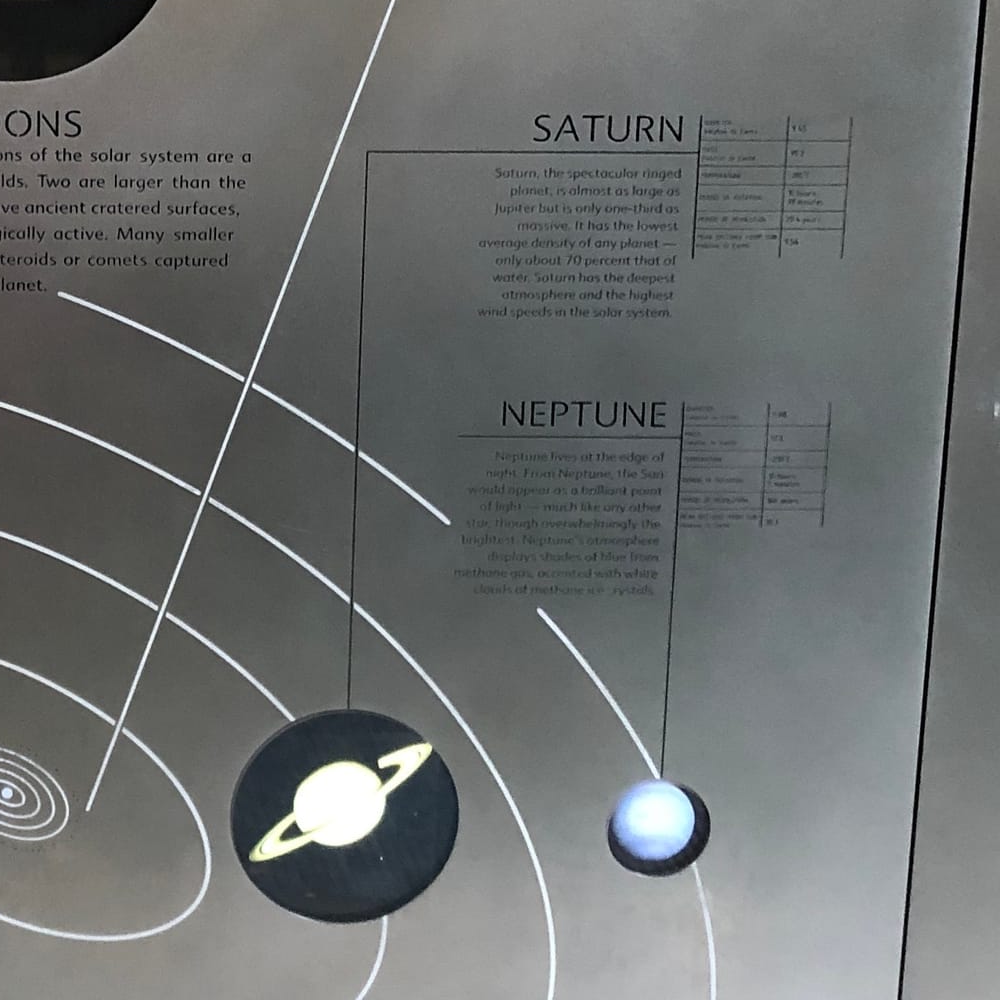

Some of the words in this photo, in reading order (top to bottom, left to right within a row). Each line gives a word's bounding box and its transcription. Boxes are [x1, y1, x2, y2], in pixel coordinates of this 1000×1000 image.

[532, 114, 685, 143] SATURN
[30, 147, 46, 162] of
[55, 147, 81, 162] the
[90, 147, 130, 162] solar
[140, 148, 198, 167] system
[207, 152, 233, 163] are
[242, 152, 251, 163] a
[37, 173, 70, 188] Two
[79, 177, 105, 188] are
[114, 174, 163, 193] larger
[173, 174, 209, 189] than
[219, 175, 245, 189] the
[25, 199, 85, 214] ancient
[91, 200, 160, 215] cratered
[167, 200, 239, 219] surfaces,
[495, 201, 534, 217] Jupiter
[539, 202, 558, 214] but
[562, 202, 572, 214] is
[575, 202, 601, 217] only
[604, 202, 662, 214] one-third
[665, 205, 679, 215] as
[54, 226, 107, 241] active.
[117, 226, 164, 245] Many
[174, 227, 233, 242] smaller
[63, 255, 80, 266] or
[88, 252, 147, 267] comets
[155, 252, 227, 271] captured
[502, 400, 667, 428] NEPTUNE
[495, 449, 547, 465] Neptune
[551, 450, 576, 462] lives
[580, 450, 592, 462] at
[596, 450, 616, 462] the
[618, 450, 648, 465] edge
[651, 450, 664, 463] of
